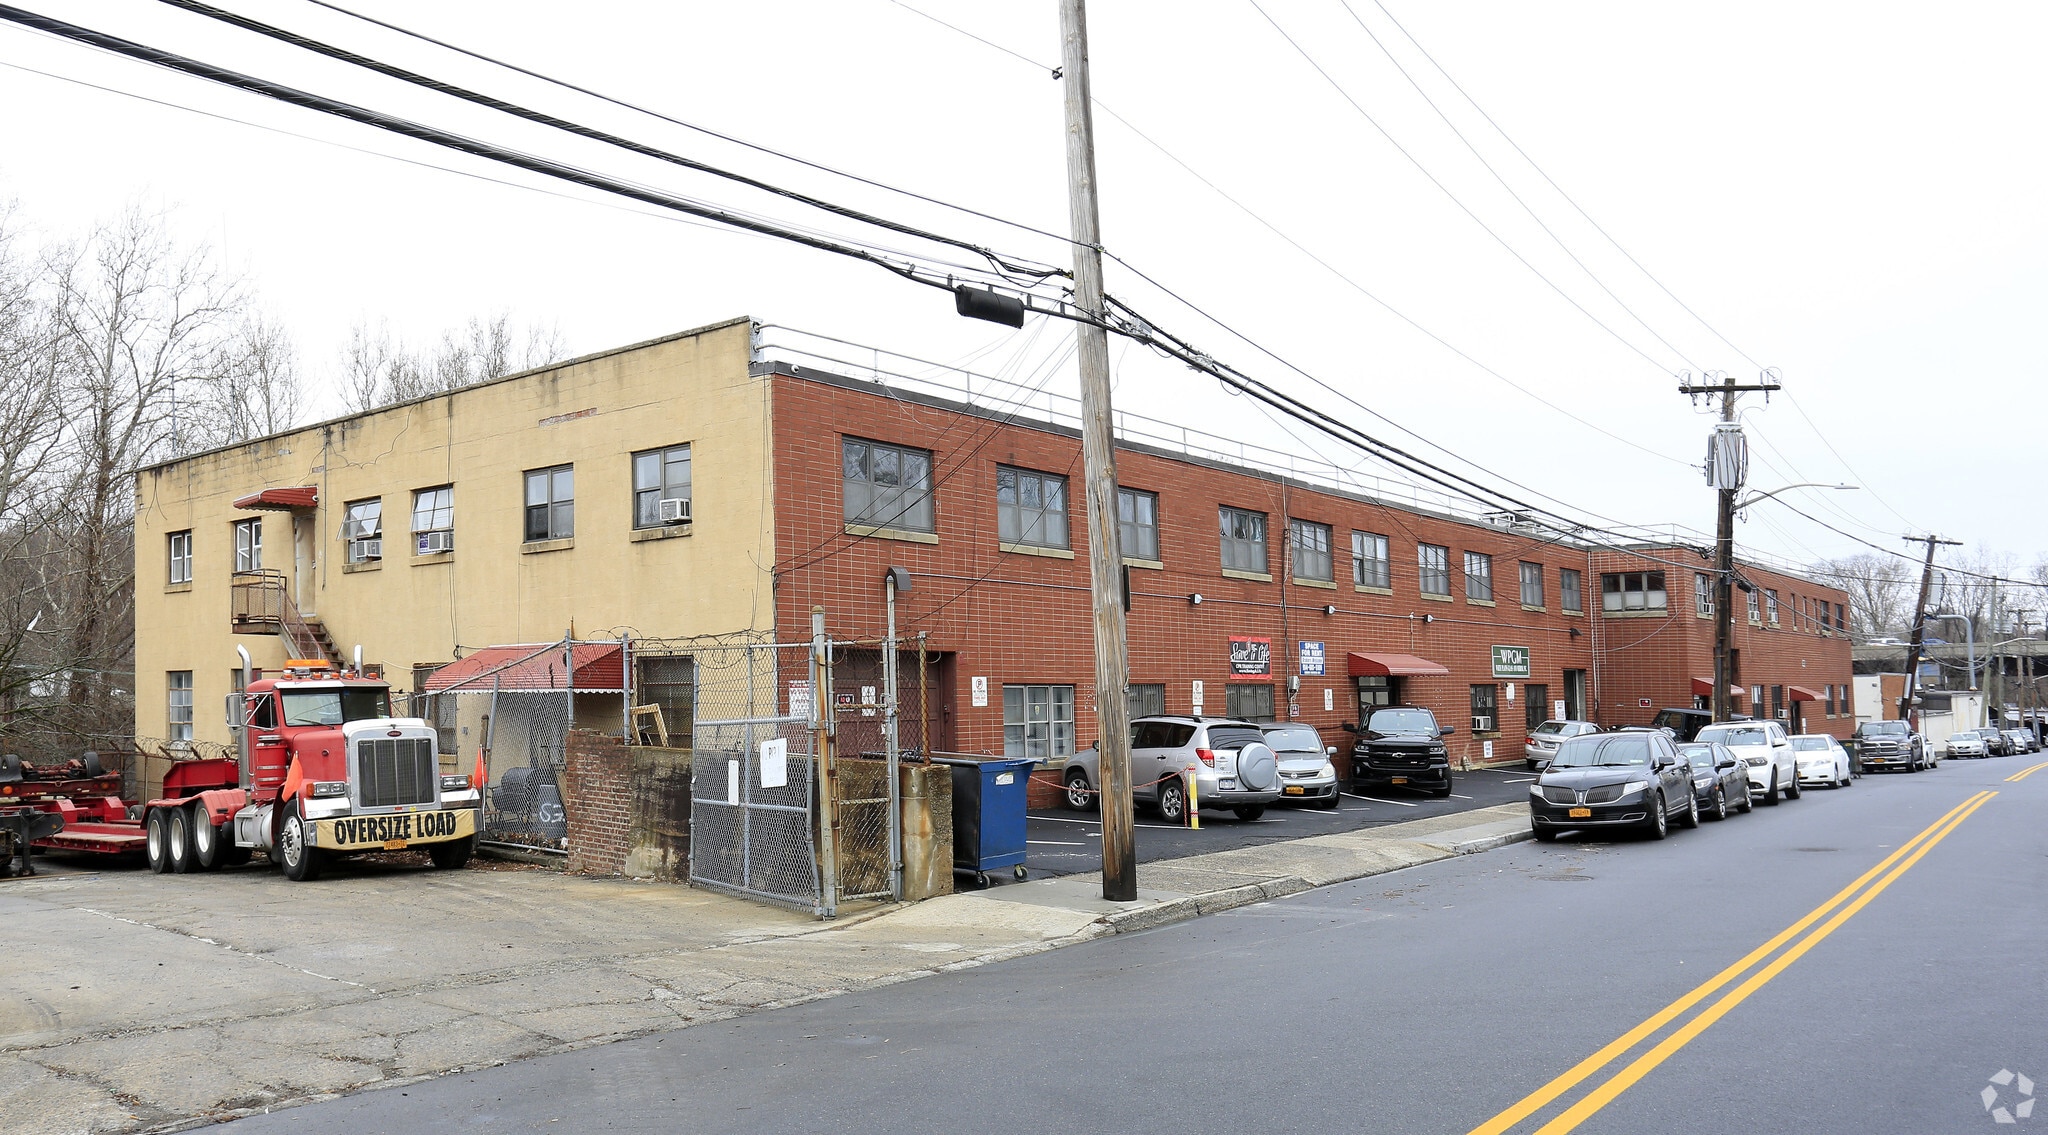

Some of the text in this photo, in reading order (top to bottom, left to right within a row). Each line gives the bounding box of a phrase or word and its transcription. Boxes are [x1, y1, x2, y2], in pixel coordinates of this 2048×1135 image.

[1304, 642, 1320, 650] SPACE
[1301, 649, 1323, 657] FOR RENT
[1500, 649, 1523, 664] WPGM
[334, 811, 457, 845] OVERSIZE LOAD
